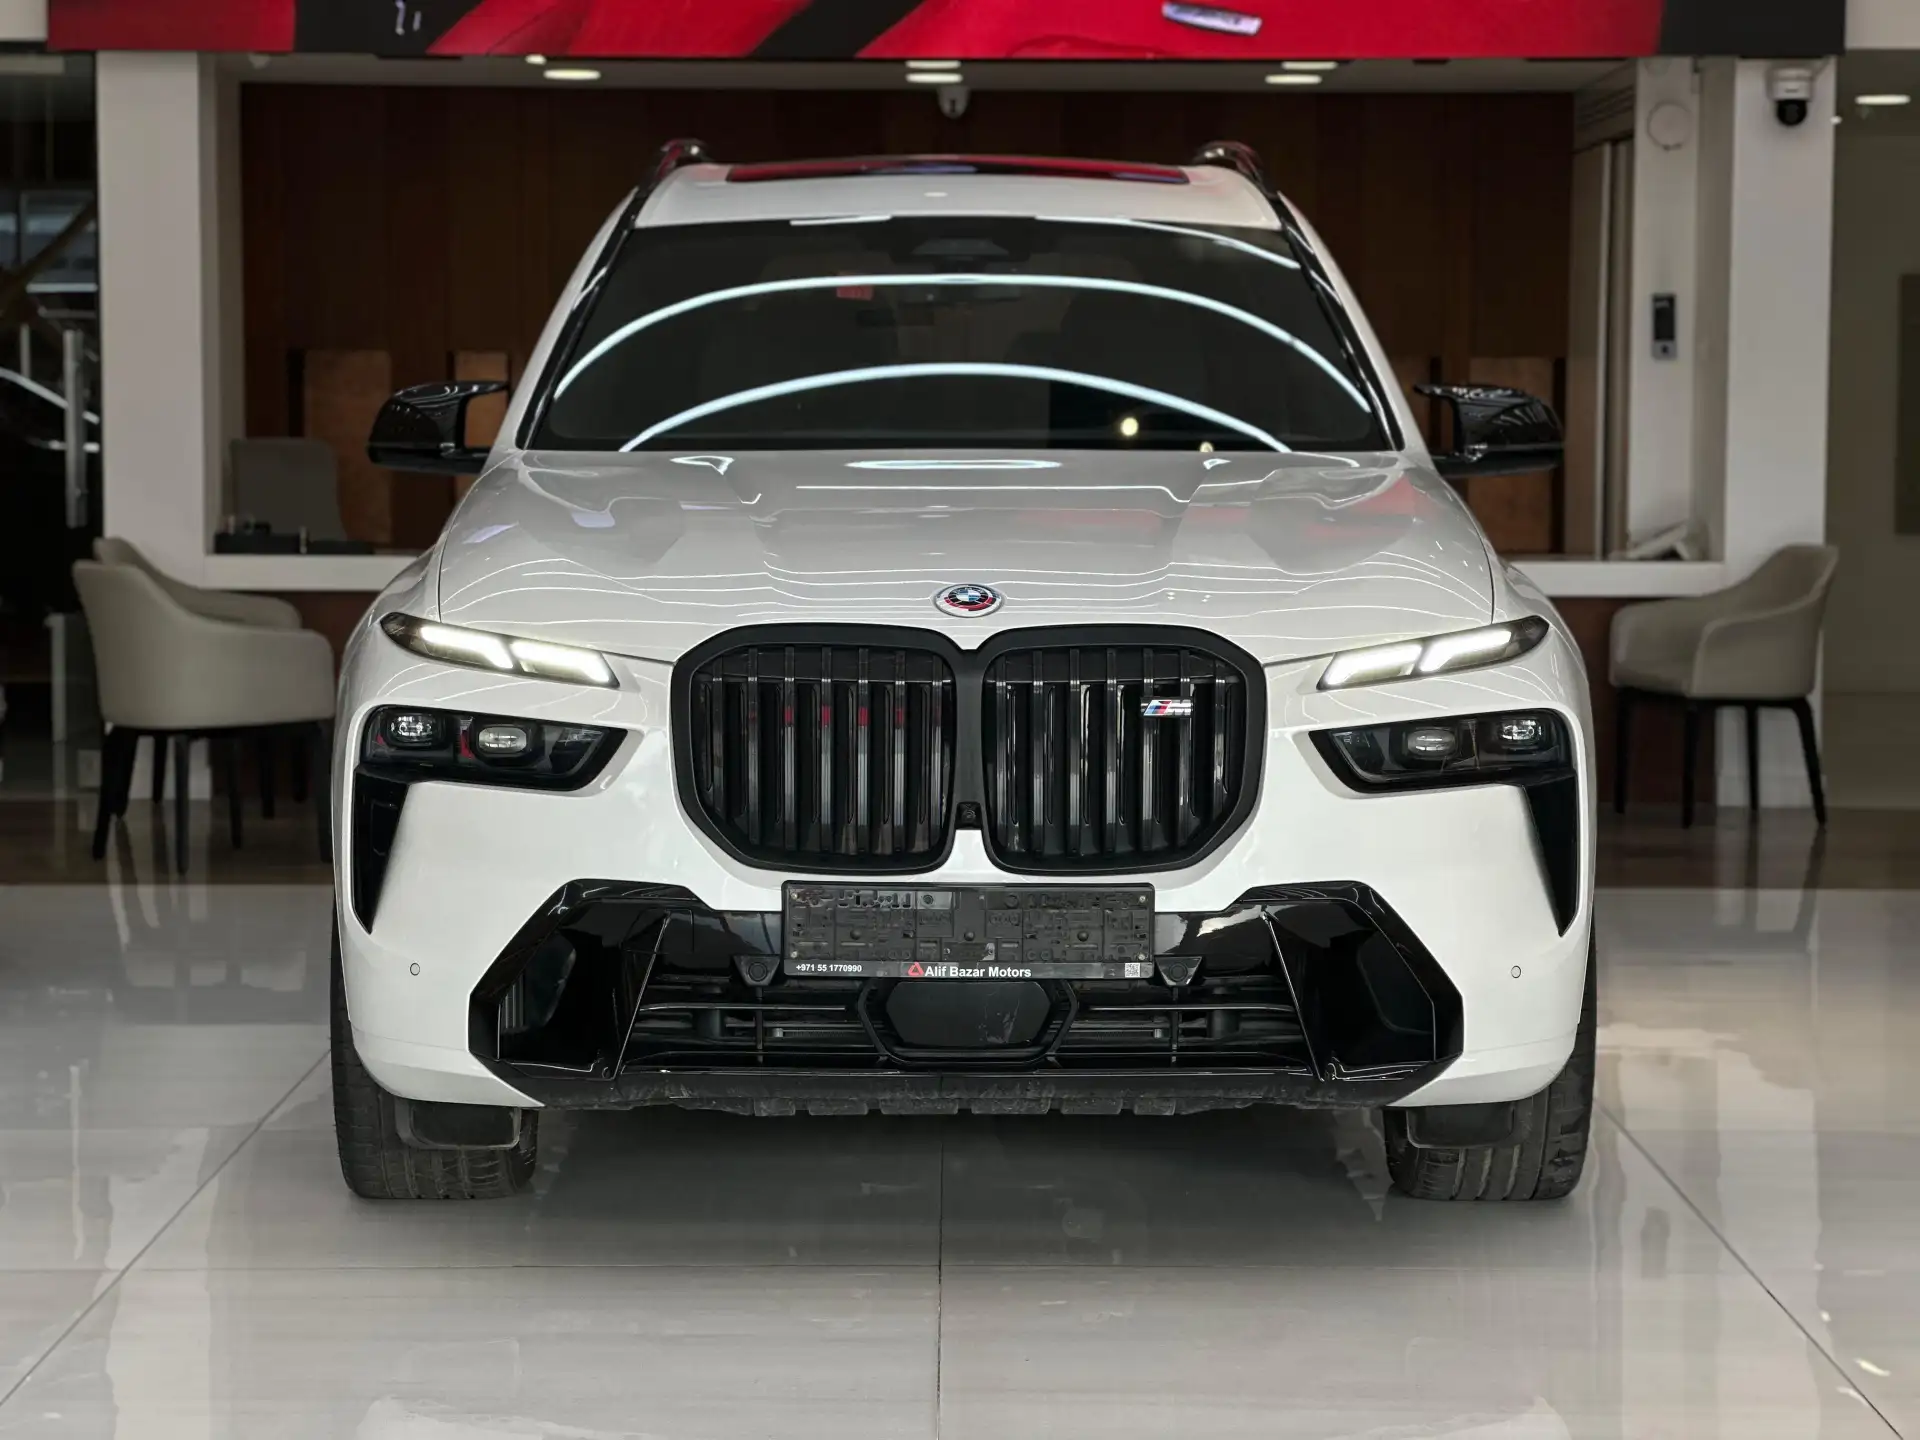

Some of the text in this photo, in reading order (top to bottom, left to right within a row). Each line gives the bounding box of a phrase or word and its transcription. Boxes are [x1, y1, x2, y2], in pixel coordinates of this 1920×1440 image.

[796, 963, 862, 973] +971 55 1770990
[924, 965, 1032, 978] Alif Bazar Motors
